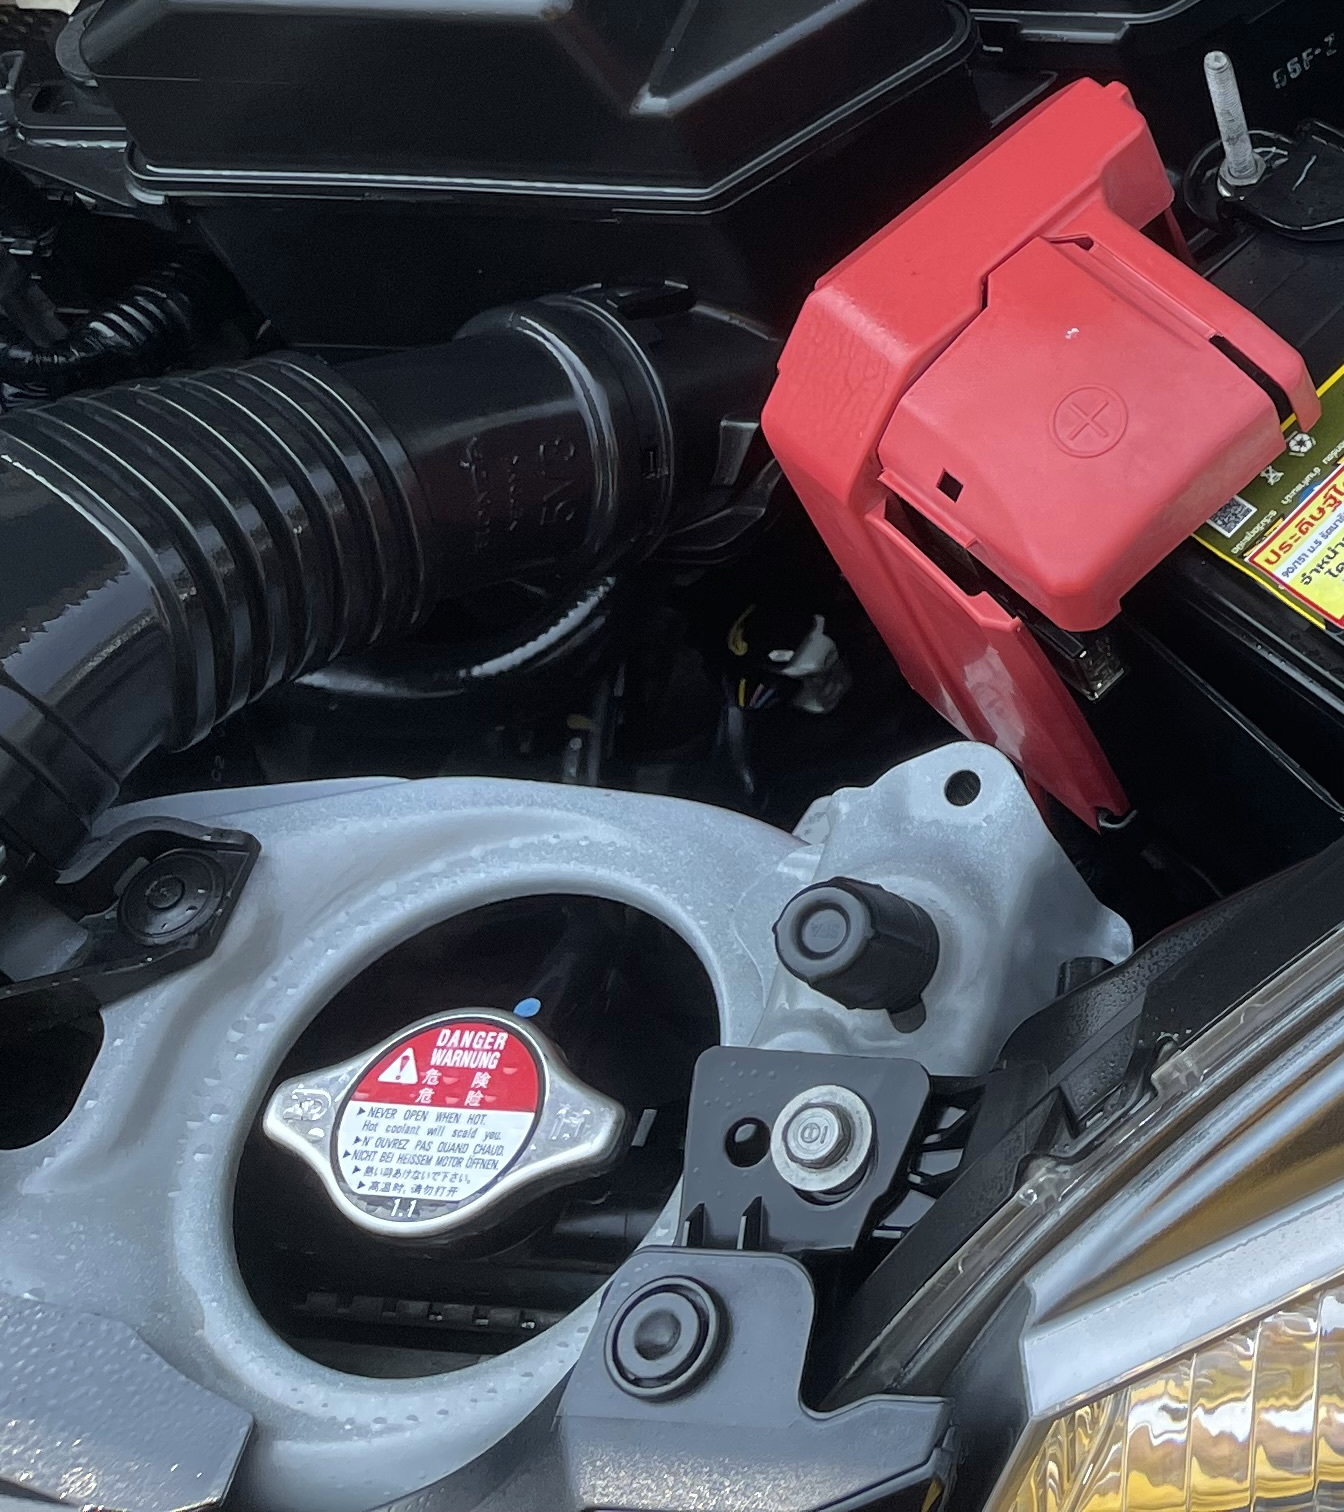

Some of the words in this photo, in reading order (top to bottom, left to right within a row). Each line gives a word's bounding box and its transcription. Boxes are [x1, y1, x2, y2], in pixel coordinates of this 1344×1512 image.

[435, 1028, 508, 1051] DANGER
[430, 1048, 500, 1070] WARNUNG
[422, 1068, 442, 1085] 危
[415, 1087, 436, 1104] 危
[368, 1106, 397, 1119] NEVER
[403, 1109, 429, 1122] OPEN
[435, 1112, 461, 1124] WHEN
[467, 1114, 487, 1125] HOT.
[362, 1120, 377, 1132] Hot
[386, 1124, 420, 1136] coolant
[427, 1127, 444, 1137] will
[452, 1129, 477, 1139] scald
[375, 1138, 408, 1150] OUVREZ
[415, 1140, 433, 1152] PAS
[437, 1142, 469, 1154] QUAND
[473, 1144, 504, 1156] CHAUD.
[351, 1149, 377, 1162] NICHT
[380, 1151, 394, 1163] BEI
[397, 1152, 433, 1166] HEISSEM
[435, 1155, 462, 1168] MOTOR
[466, 1155, 499, 1171] ÖFFNEN.
